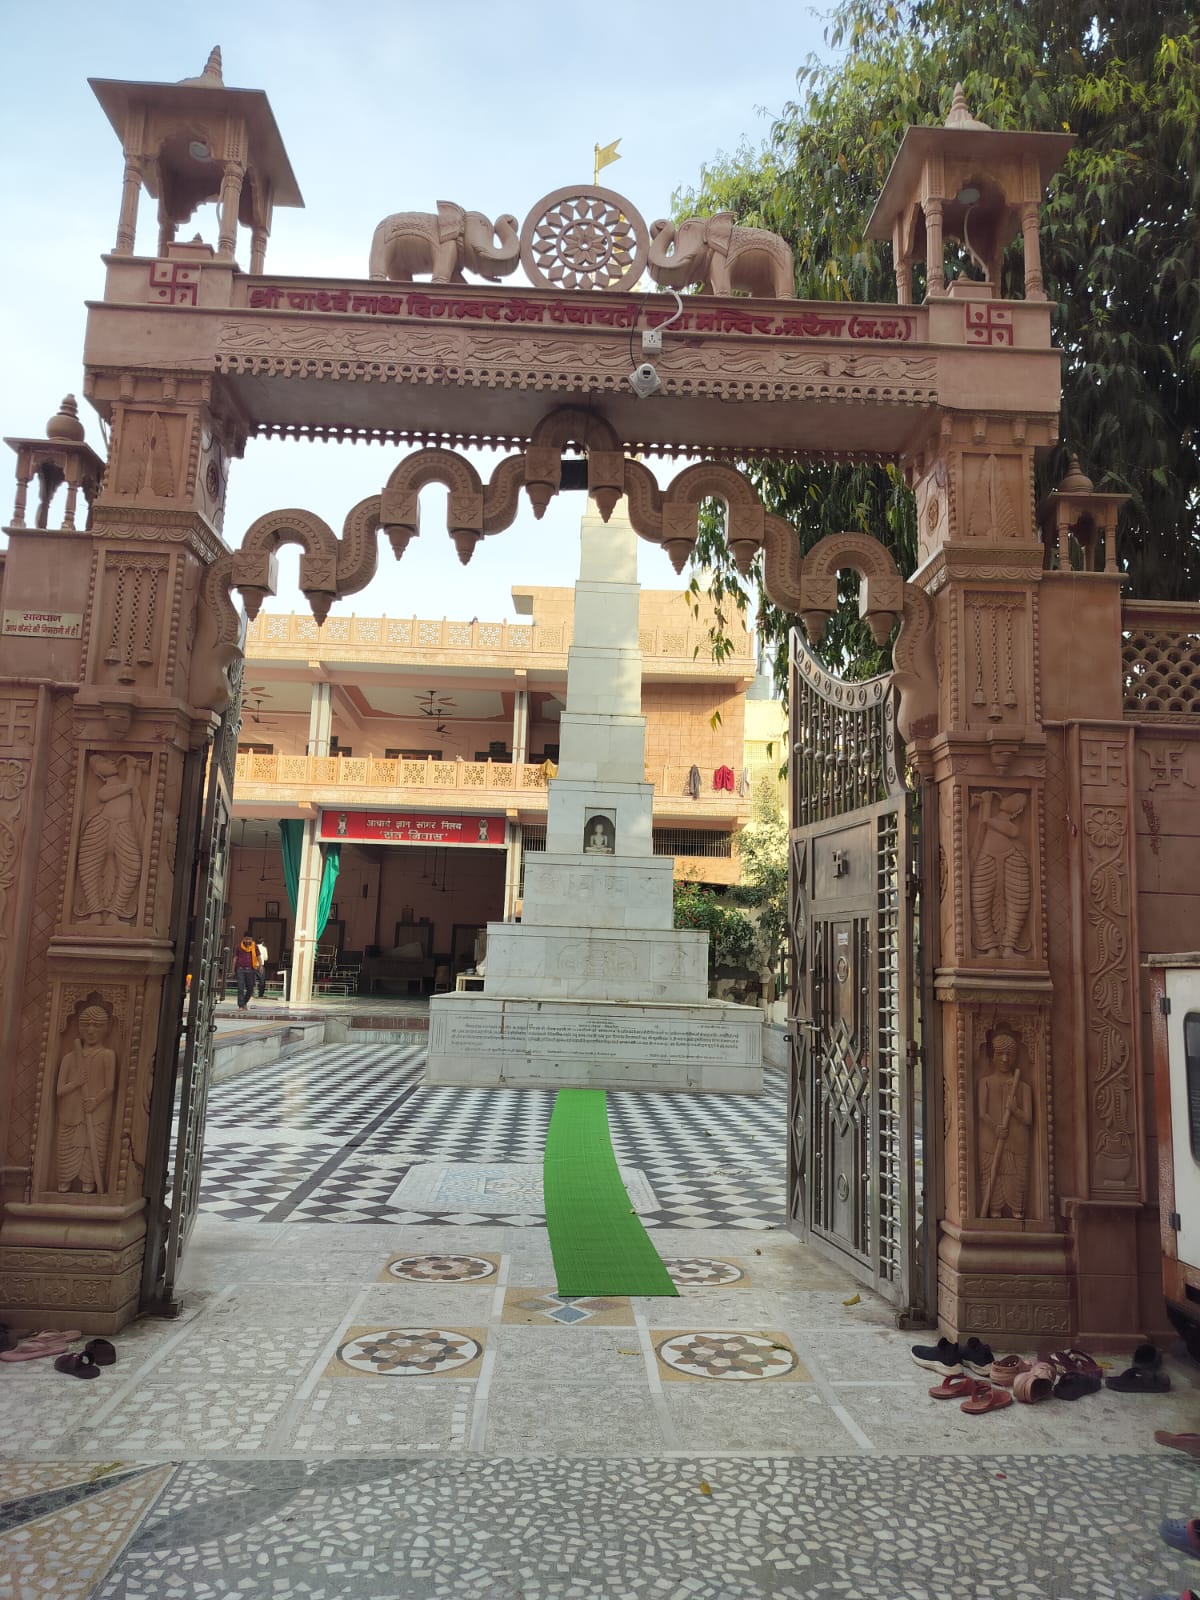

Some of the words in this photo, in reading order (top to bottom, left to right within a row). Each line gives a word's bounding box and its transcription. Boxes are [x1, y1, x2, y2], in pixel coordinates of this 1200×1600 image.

[249, 285, 285, 310] श्री
[406, 292, 505, 321] दिगम्बर
[503, 298, 547, 323] जैन
[547, 300, 642, 328] पंचायती
[23, 613, 62, 622] सावधान
[6, 624, 17, 632] आप
[395, 820, 411, 829] ज्ञान
[415, 820, 437, 829] सागर
